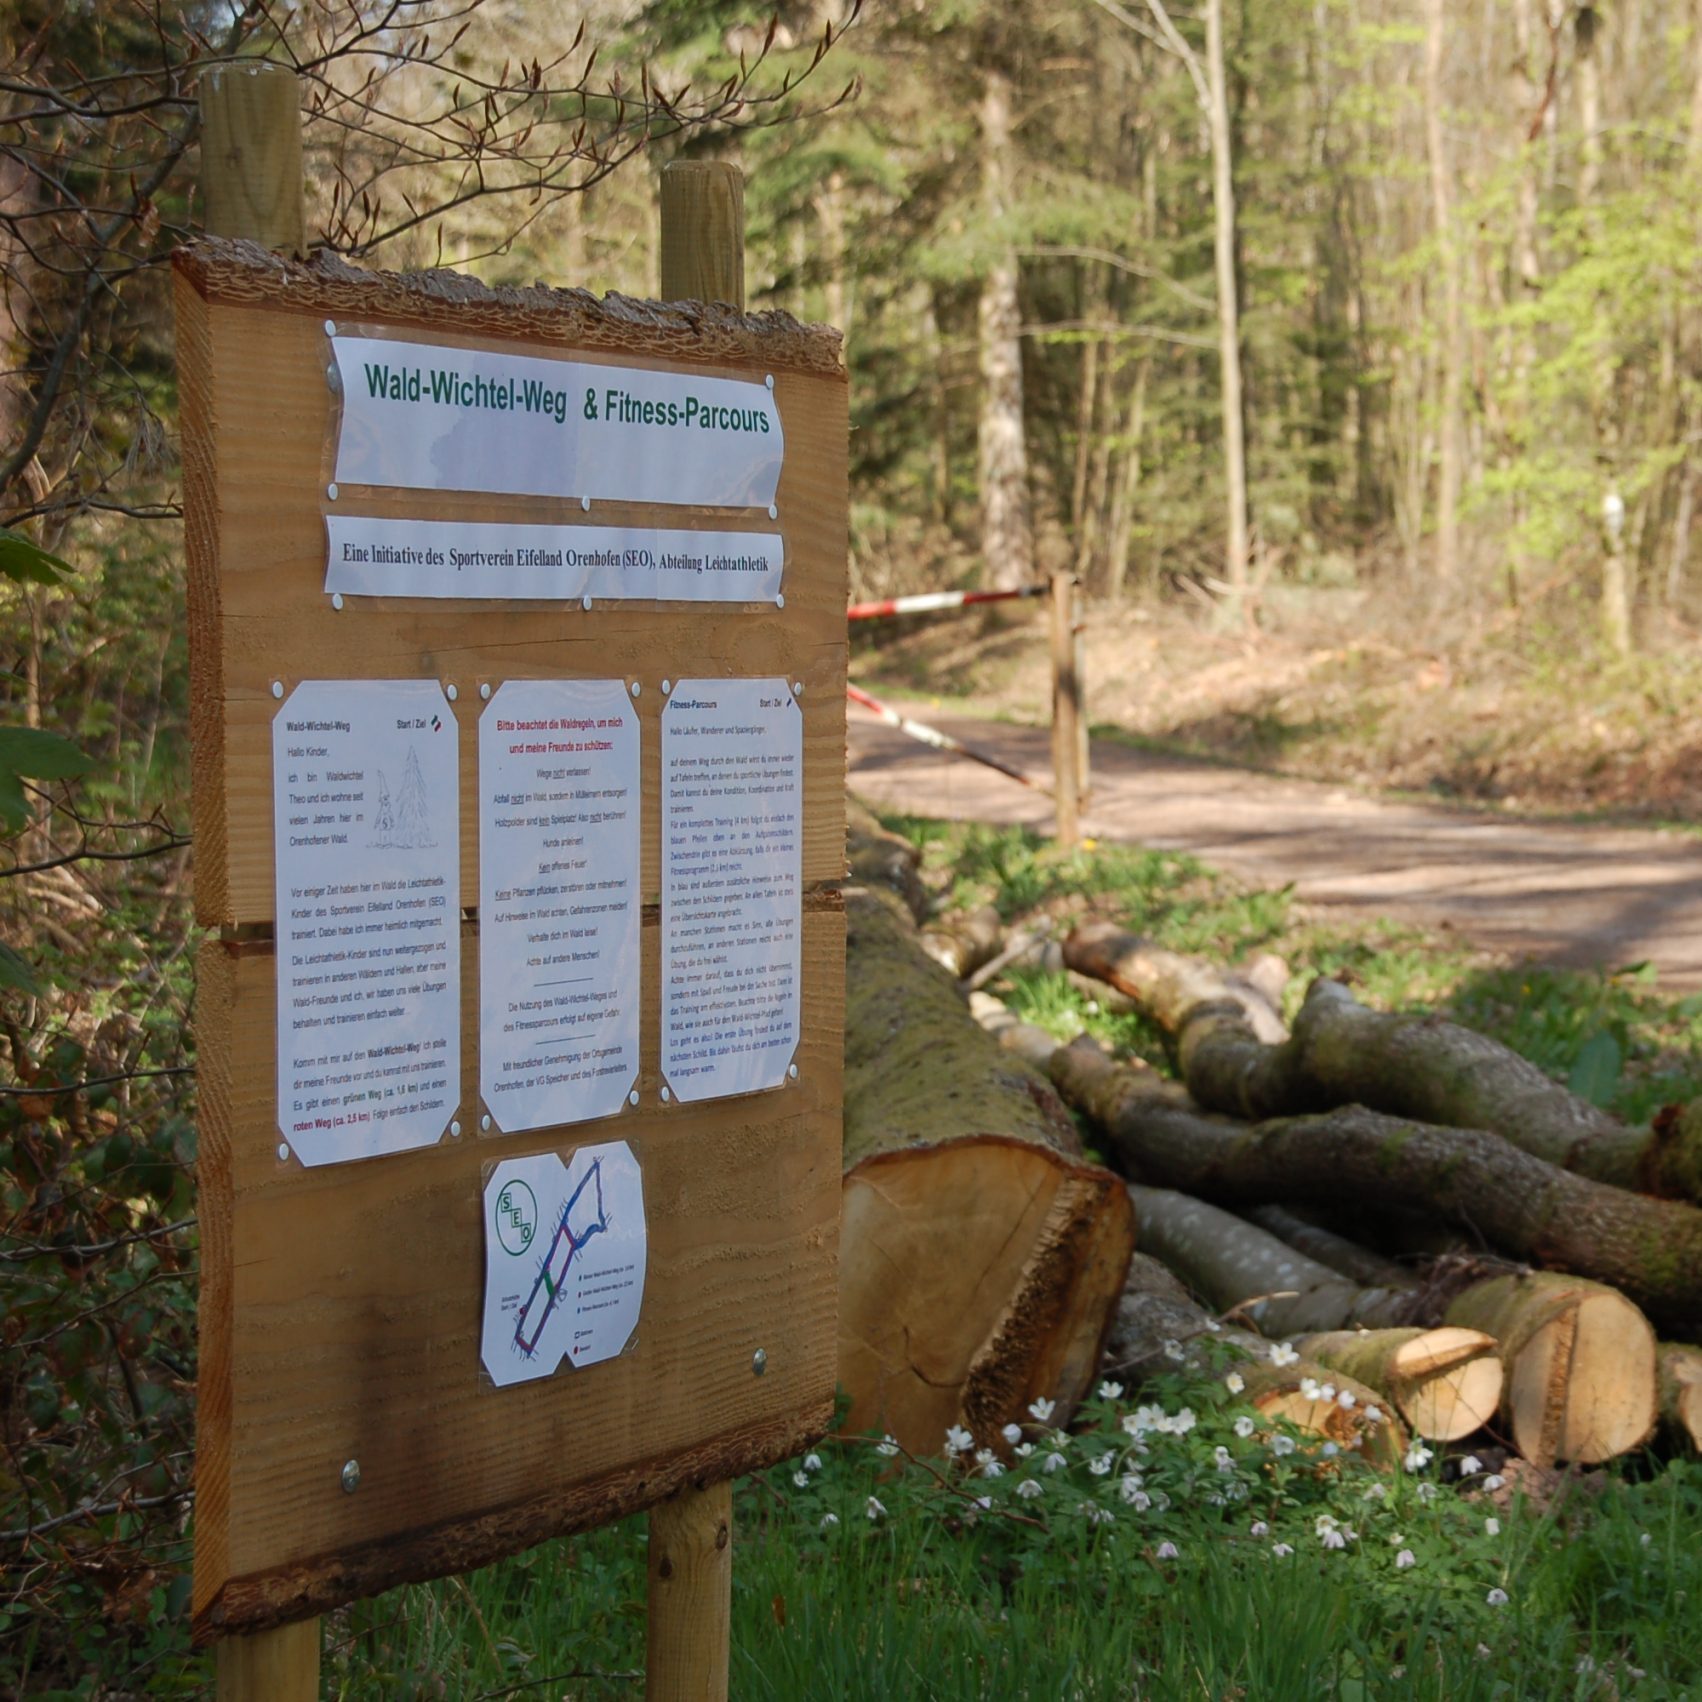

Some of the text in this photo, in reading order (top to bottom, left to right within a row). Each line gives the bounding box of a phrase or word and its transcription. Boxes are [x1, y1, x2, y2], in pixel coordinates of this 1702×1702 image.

[365, 364, 770, 433] Wald-Wichtel-Weg & Fitness-Parcours
[343, 543, 769, 573] Eine Initiative des Sportverein Eifelland Orenhofen (SEO), Abteilung Leichtathletik
[670, 700, 716, 708] Fitness-Parcours
[287, 721, 350, 732] Wald-Wichtel-Weg
[397, 720, 411, 729] Start
[497, 720, 514, 731] Bitte
[517, 720, 547, 730] beachtet
[608, 717, 622, 727] mich
[288, 748, 329, 757] Hallo Kinder,
[509, 744, 523, 753] und
[526, 743, 546, 753] meine
[548, 742, 574, 752] Freunde
[290, 794, 305, 804] Theo
[307, 795, 319, 803] und
[331, 793, 351, 801] wohne
[313, 815, 335, 823] Jahren
[340, 885, 359, 893] haben
[382, 880, 396, 890] Wald
[291, 909, 312, 918] Kinder
[319, 927, 337, 938] Dabei
[339, 926, 353, 935] habe
[340, 993, 352, 1002] und
[323, 1015, 335, 1025] und
[354, 1051, 366, 1061] den
[326, 1073, 352, 1085] Freunde
[306, 1098, 319, 1111] gibt
[322, 1097, 340, 1107] einen
[368, 1090, 381, 1101] Weg
[293, 1121, 313, 1132] roten
[315, 1117, 331, 1129] Weg
